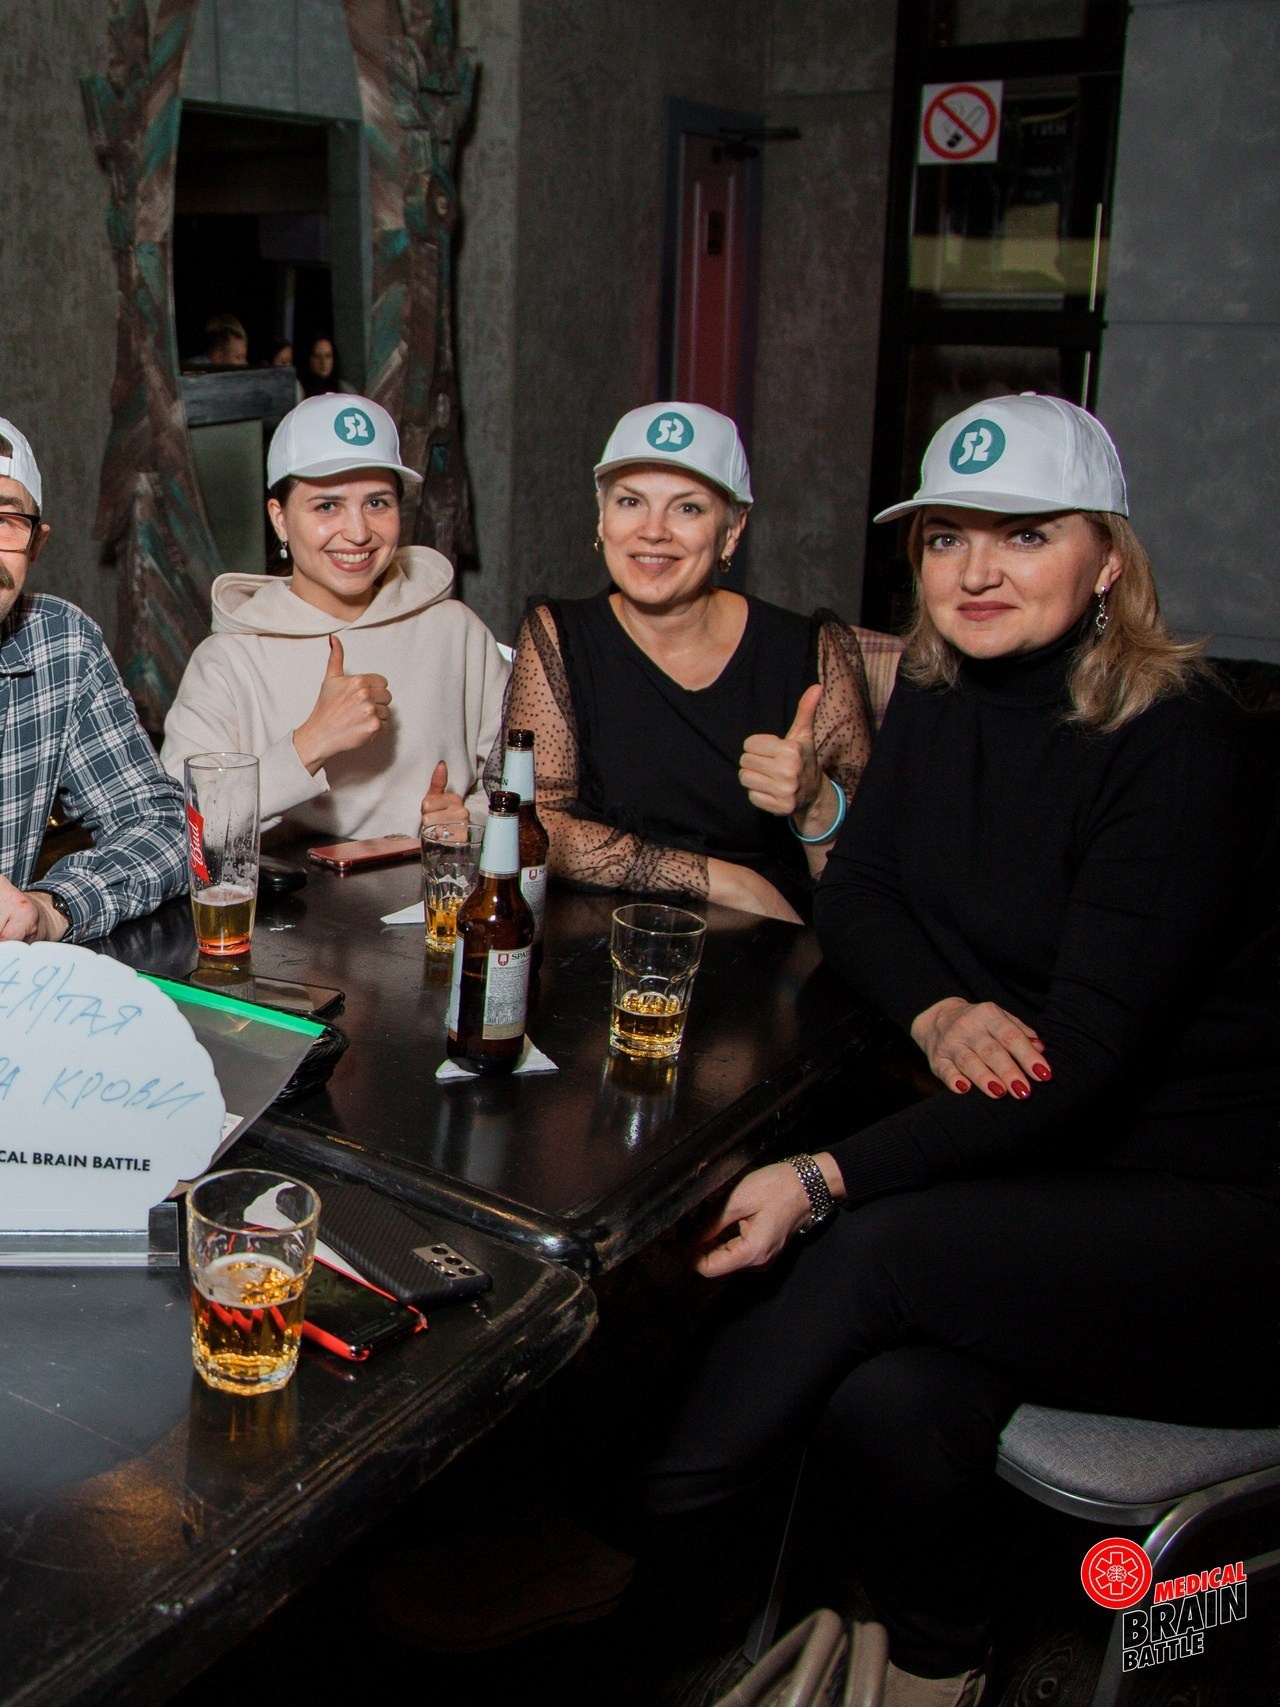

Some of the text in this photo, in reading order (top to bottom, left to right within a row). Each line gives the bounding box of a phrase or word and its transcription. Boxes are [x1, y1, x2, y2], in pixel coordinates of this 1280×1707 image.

[343, 412, 369, 440] 52
[655, 418, 684, 445] 52
[957, 427, 992, 466] 52
[190, 820, 205, 868] Bud
[42, 1067, 206, 1120] КРОВИ
[32, 1152, 88, 1168] BRAIN
[92, 1156, 151, 1172] BATTLE
